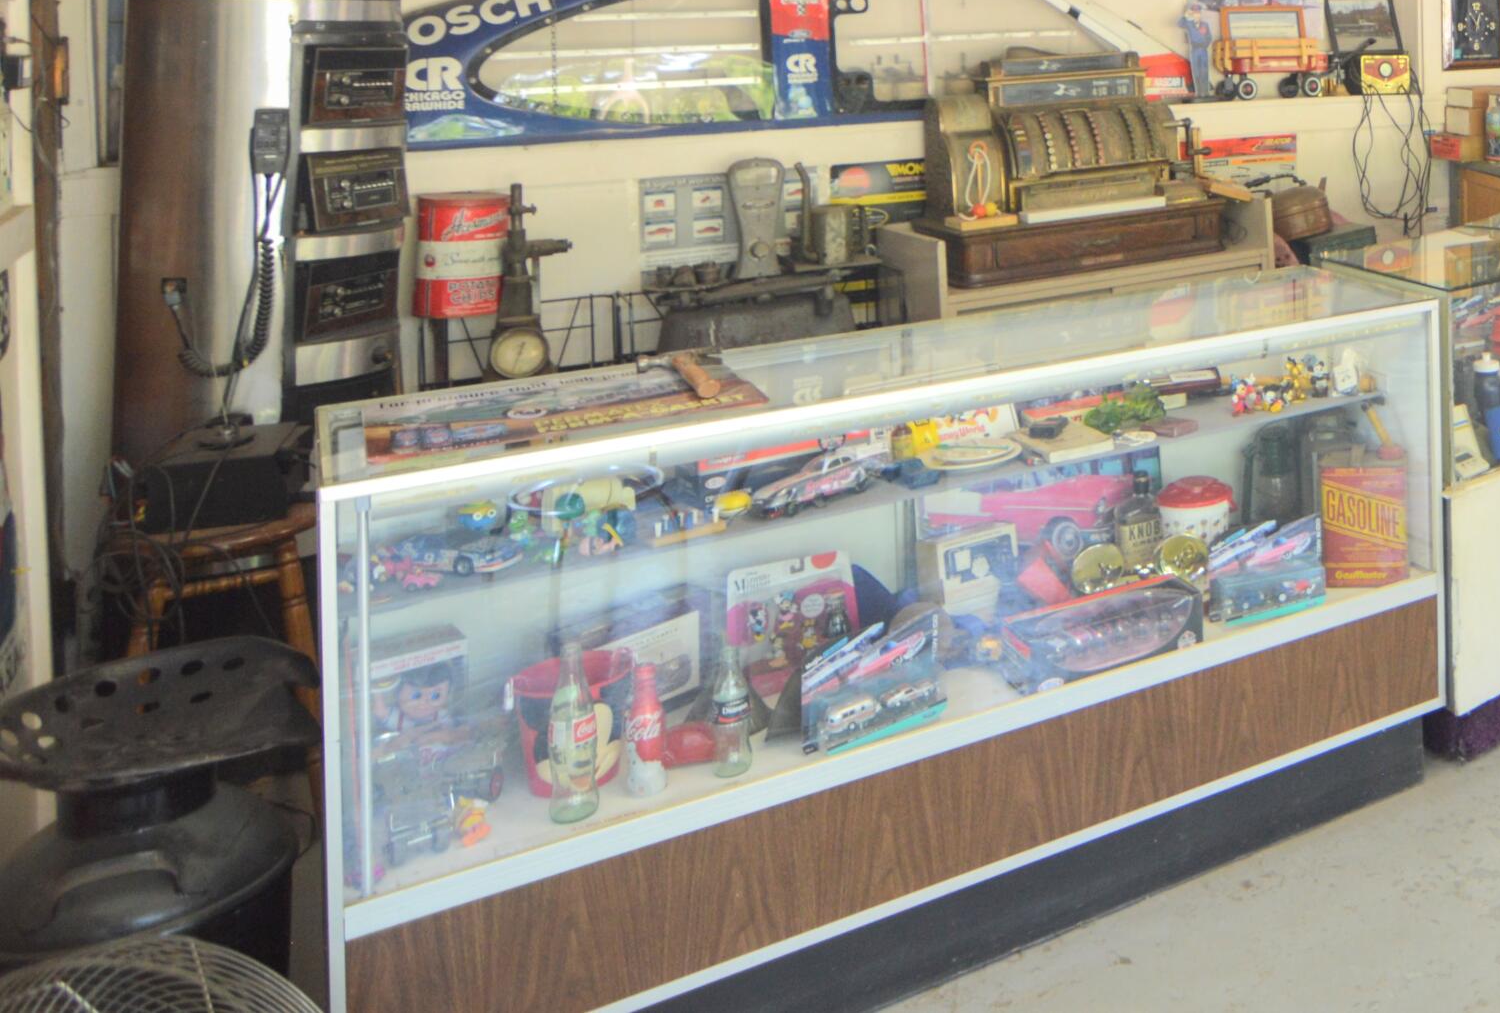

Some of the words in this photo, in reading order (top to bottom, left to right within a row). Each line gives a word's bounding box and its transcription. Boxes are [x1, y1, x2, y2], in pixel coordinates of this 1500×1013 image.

[1471, 2, 1481, 12] 12
[786, 52, 818, 75] CR
[405, 56, 465, 92] CR
[405, 91, 466, 102] CHICAGO
[405, 100, 465, 112] RAWHIDE
[886, 161, 926, 177] MON
[450, 289, 497, 305] CHIPS
[1325, 488, 1402, 540] GASOLINE
